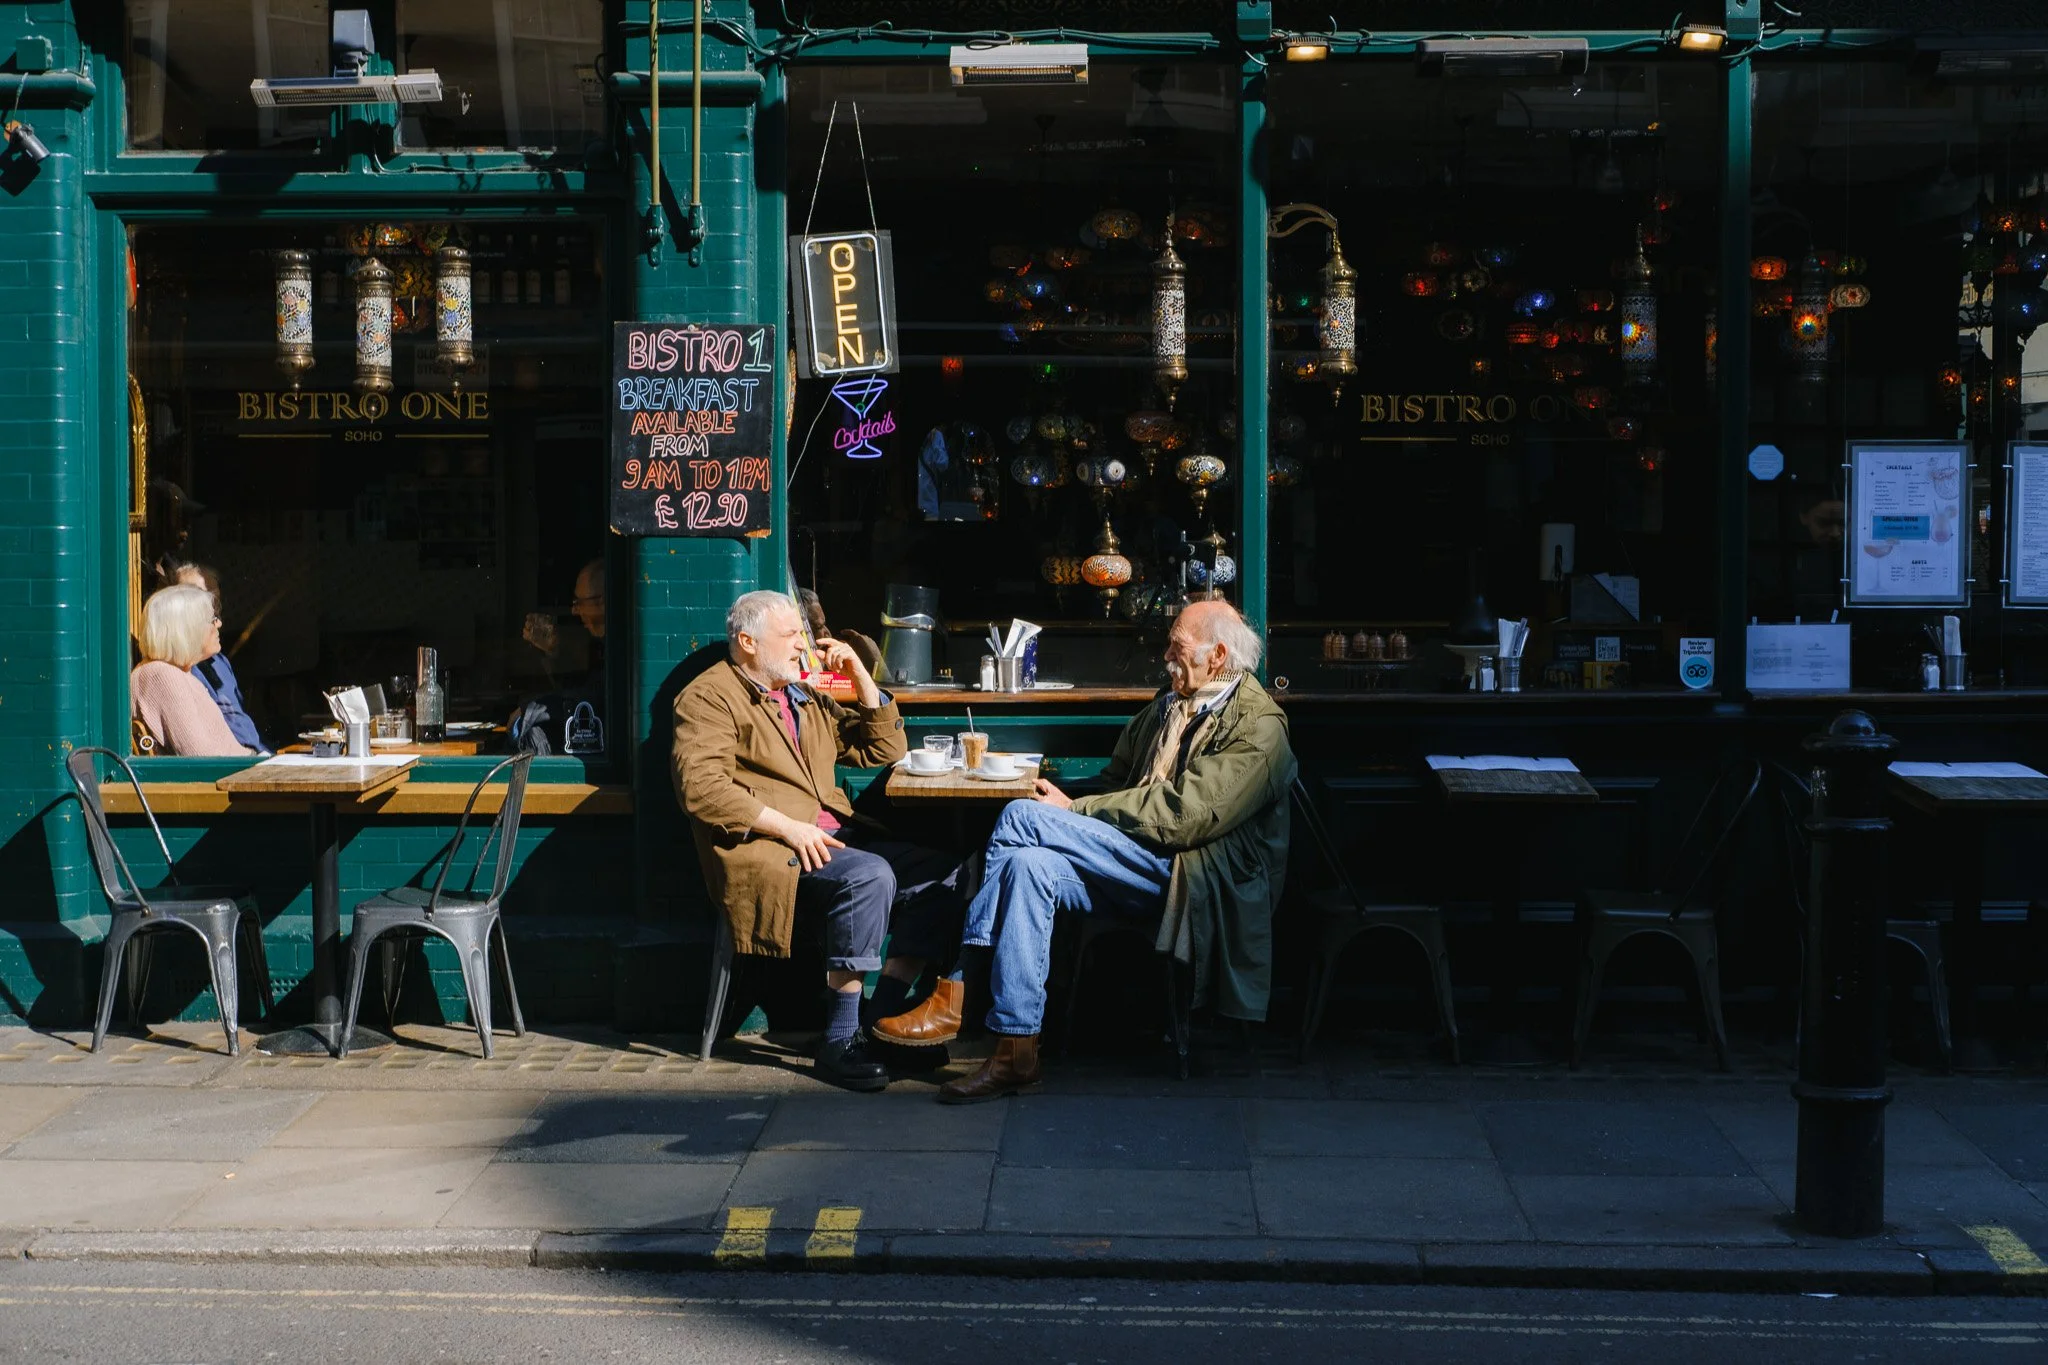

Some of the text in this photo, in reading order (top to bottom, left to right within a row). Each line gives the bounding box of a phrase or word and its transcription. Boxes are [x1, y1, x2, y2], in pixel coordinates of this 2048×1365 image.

[828, 241, 865, 368] OPEN
[628, 328, 772, 373] BISTRO 1
[237, 392, 489, 420] BISTRO ONE
[618, 377, 760, 412] BREAKFAST
[1360, 394, 1517, 422] BISTRO
[344, 430, 383, 442] SOHO
[631, 410, 739, 435] AVAILABLE
[833, 410, 896, 449] Cocktails
[649, 434, 709, 458] FROM
[1471, 434, 1511, 446] SOHO
[689, 460, 722, 490] TO
[725, 457, 771, 491] 1PM
[682, 492, 748, 529] 12.90
